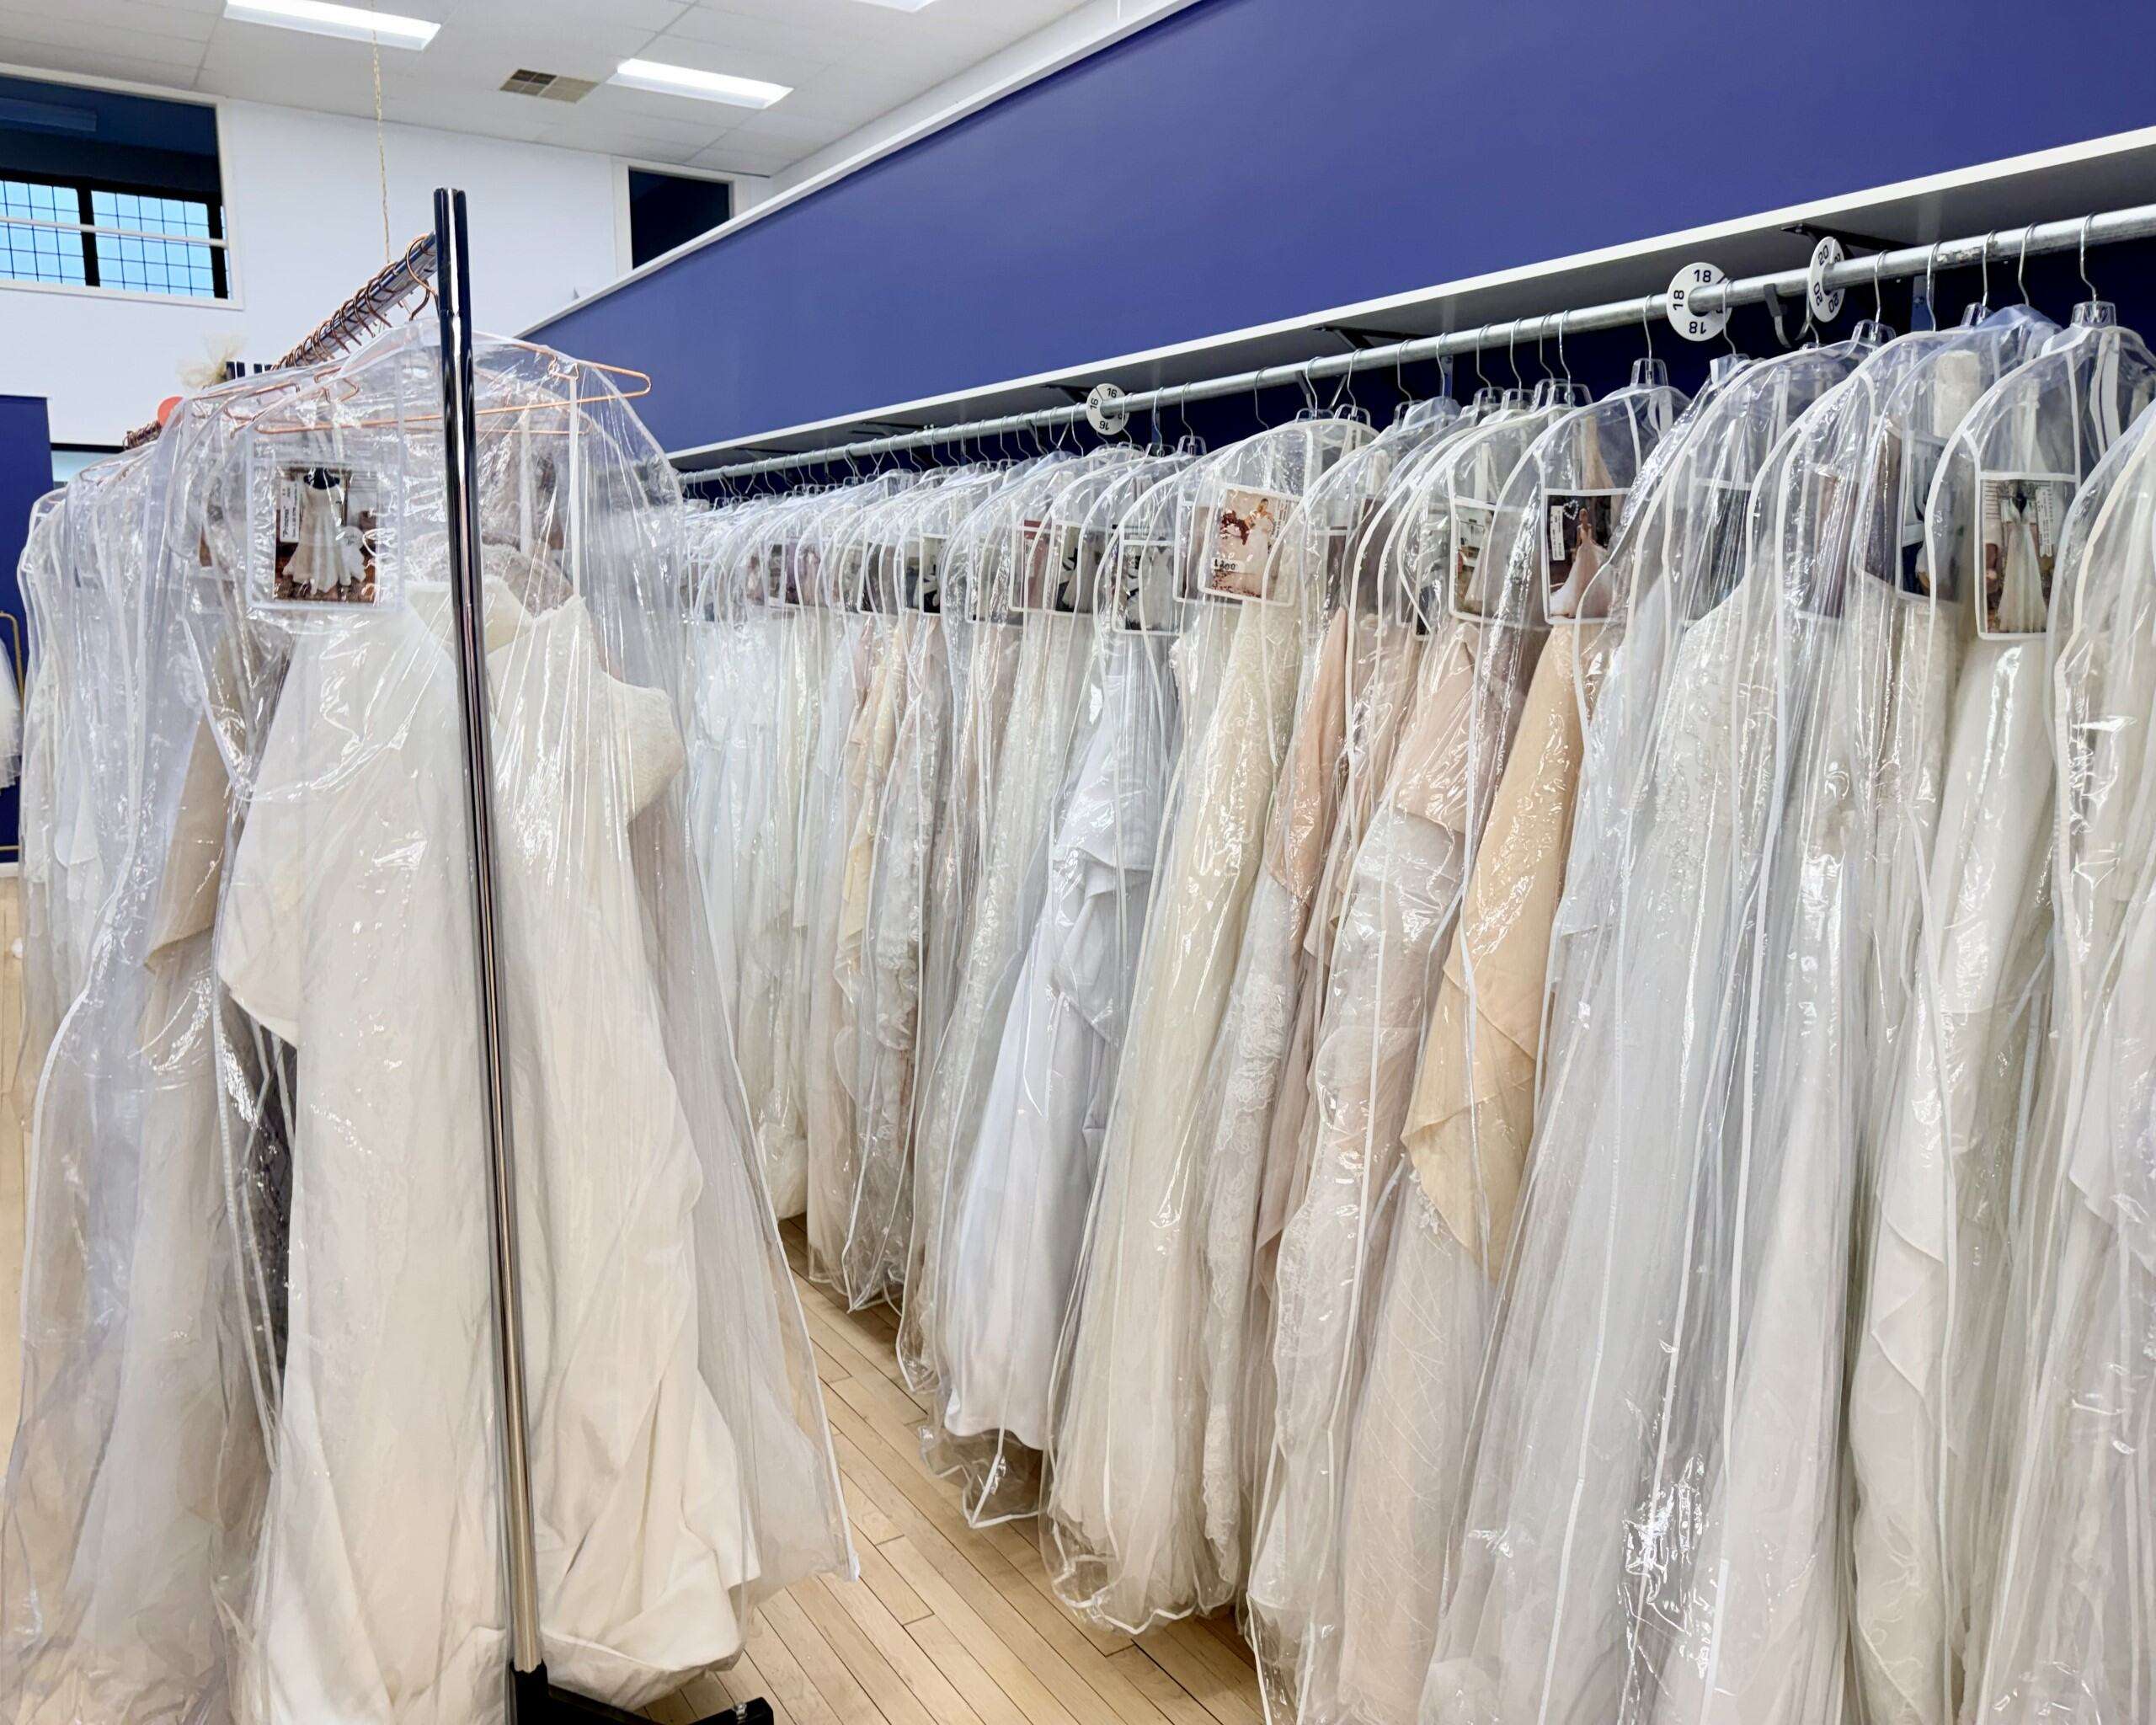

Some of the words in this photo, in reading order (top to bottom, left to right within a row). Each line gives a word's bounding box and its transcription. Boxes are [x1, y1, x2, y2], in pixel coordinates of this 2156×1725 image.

[1817, 244, 1829, 266] 20
[1694, 269, 1712, 283] 18
[1673, 290, 1684, 311] 18
[1813, 281, 1822, 306] 20
[1828, 292, 1839, 313] 20
[1689, 321, 1707, 334] 18
[1107, 387, 1117, 398] 16
[1090, 398, 1098, 409] 16
[1099, 420, 1110, 430] 16
